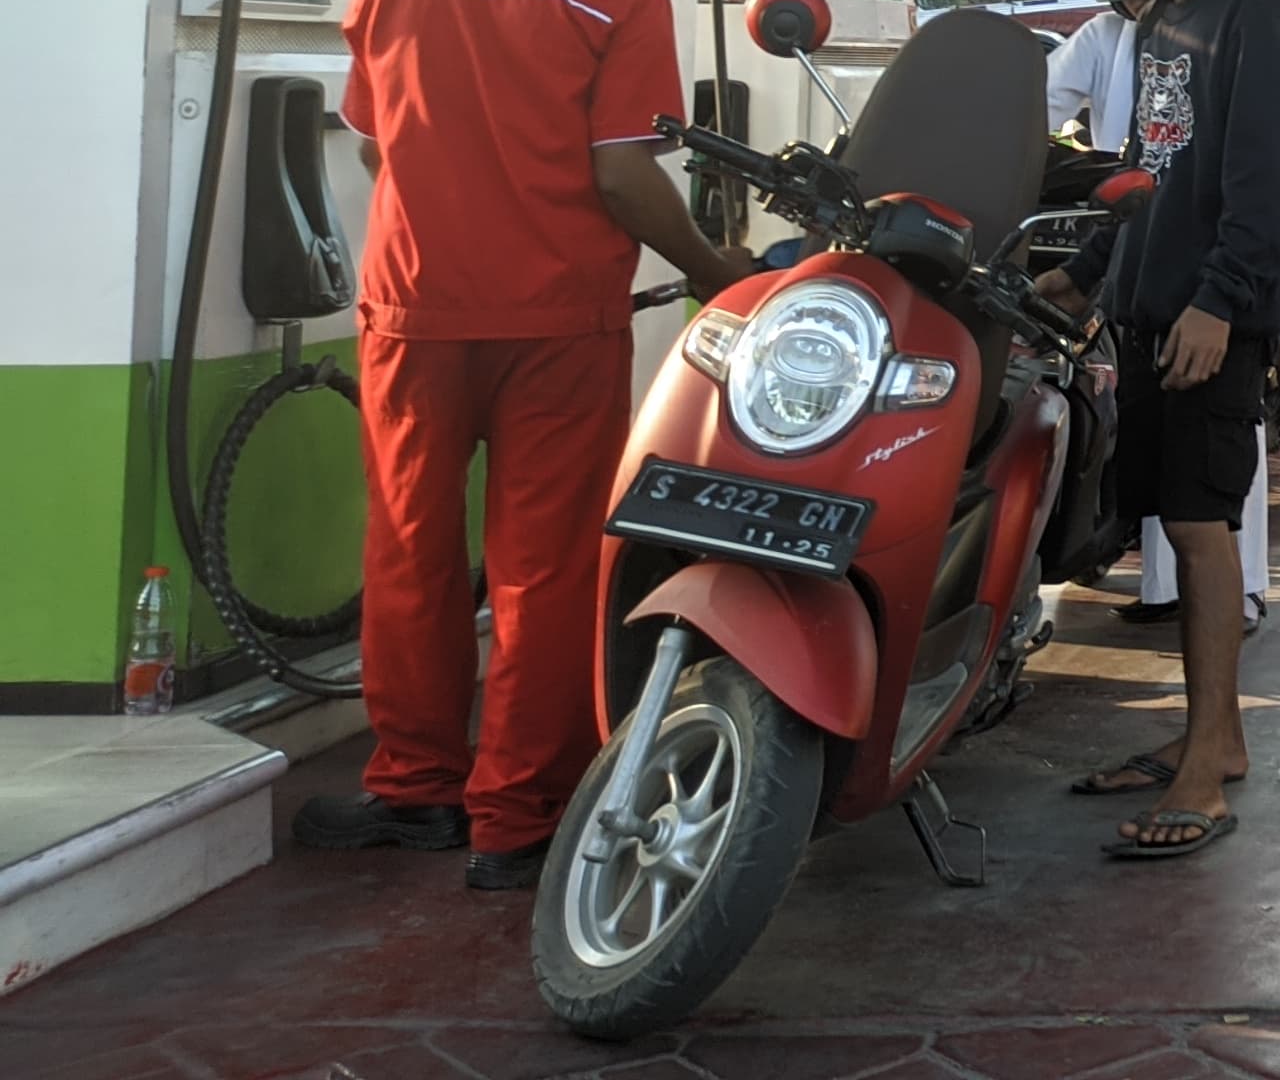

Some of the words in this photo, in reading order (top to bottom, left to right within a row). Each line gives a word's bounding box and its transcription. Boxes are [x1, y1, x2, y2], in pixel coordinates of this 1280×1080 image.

[925, 218, 965, 245] HONDA
[650, 475, 676, 500] S
[693, 482, 780, 519] 4322
[799, 503, 847, 533] GN
